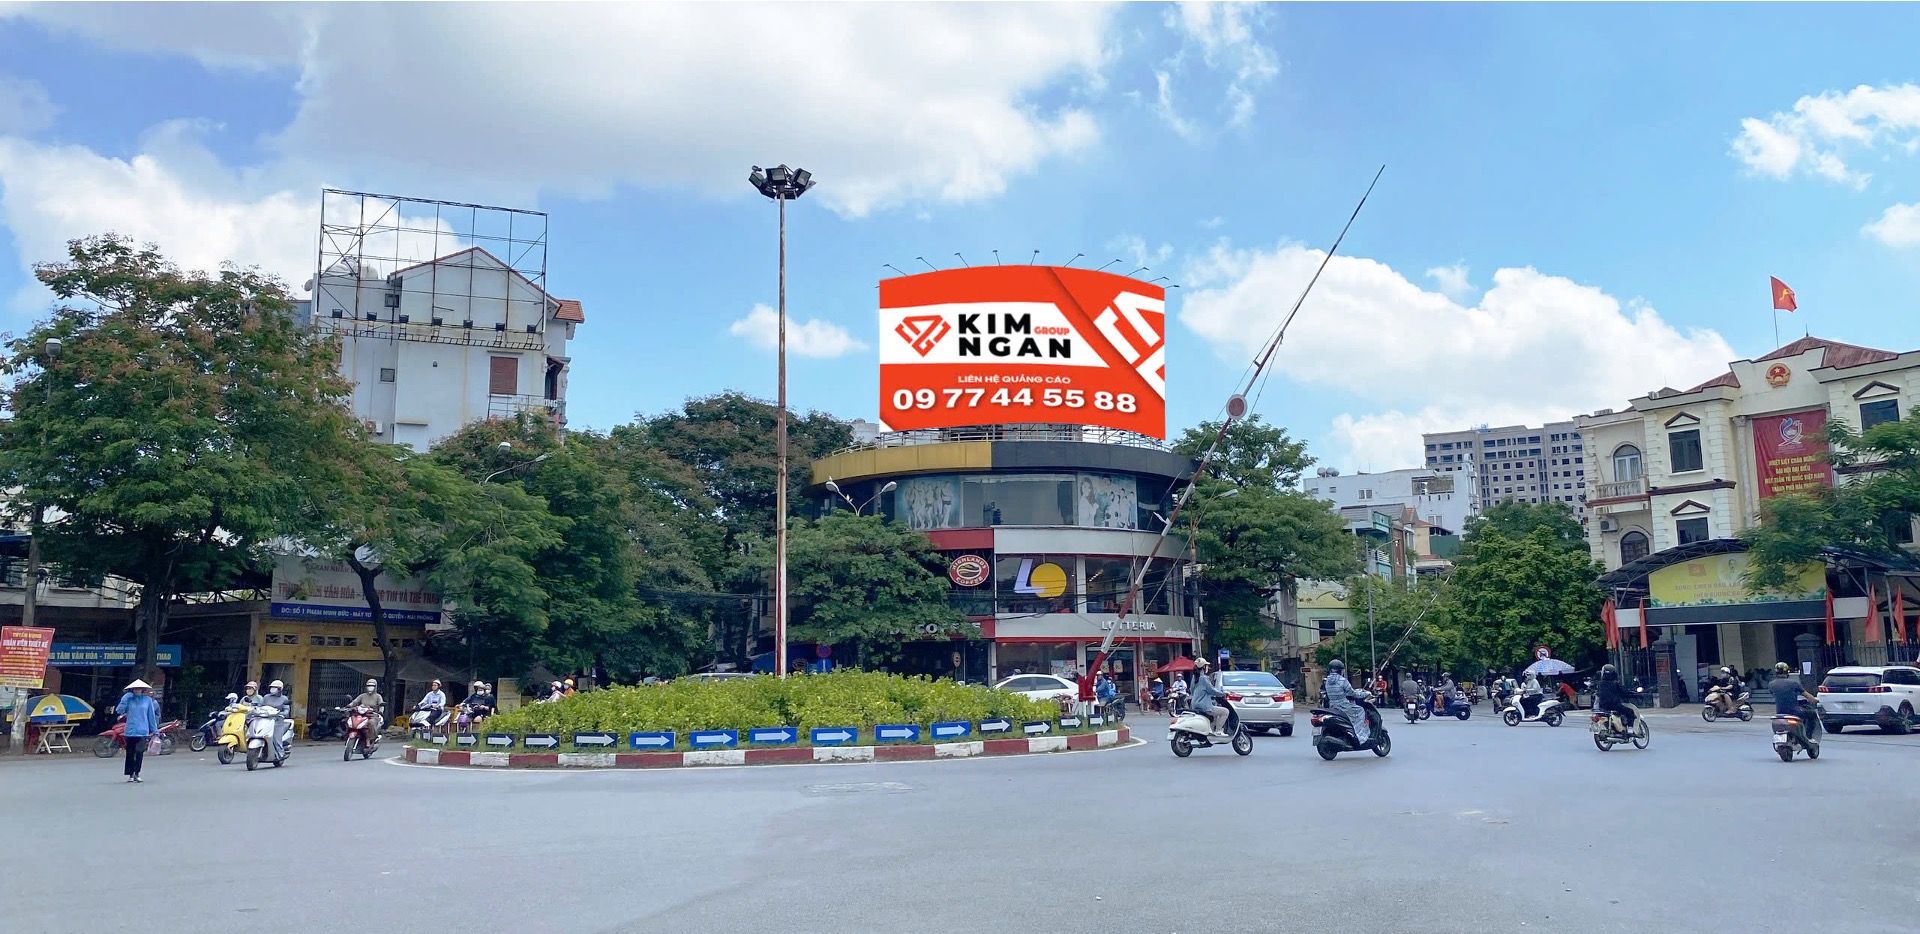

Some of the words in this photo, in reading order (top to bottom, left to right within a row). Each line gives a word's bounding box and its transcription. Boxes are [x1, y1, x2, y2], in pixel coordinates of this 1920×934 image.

[958, 313, 1031, 334] KIM
[1034, 326, 1070, 335] GROUP
[958, 337, 1071, 358] NGAN
[958, 374, 982, 383] LIÊN
[985, 374, 1000, 384] HỆ
[1002, 374, 1043, 384] QUẢNG
[1045, 374, 1071, 384] CÁO
[893, 388, 936, 410] 09
[942, 388, 985, 408] 77
[990, 388, 1034, 407] 44
[1043, 388, 1085, 408] 55
[1093, 391, 1137, 413] 88
[952, 557, 986, 570] HIGHLANDS
[956, 576, 984, 585] COFFEE
